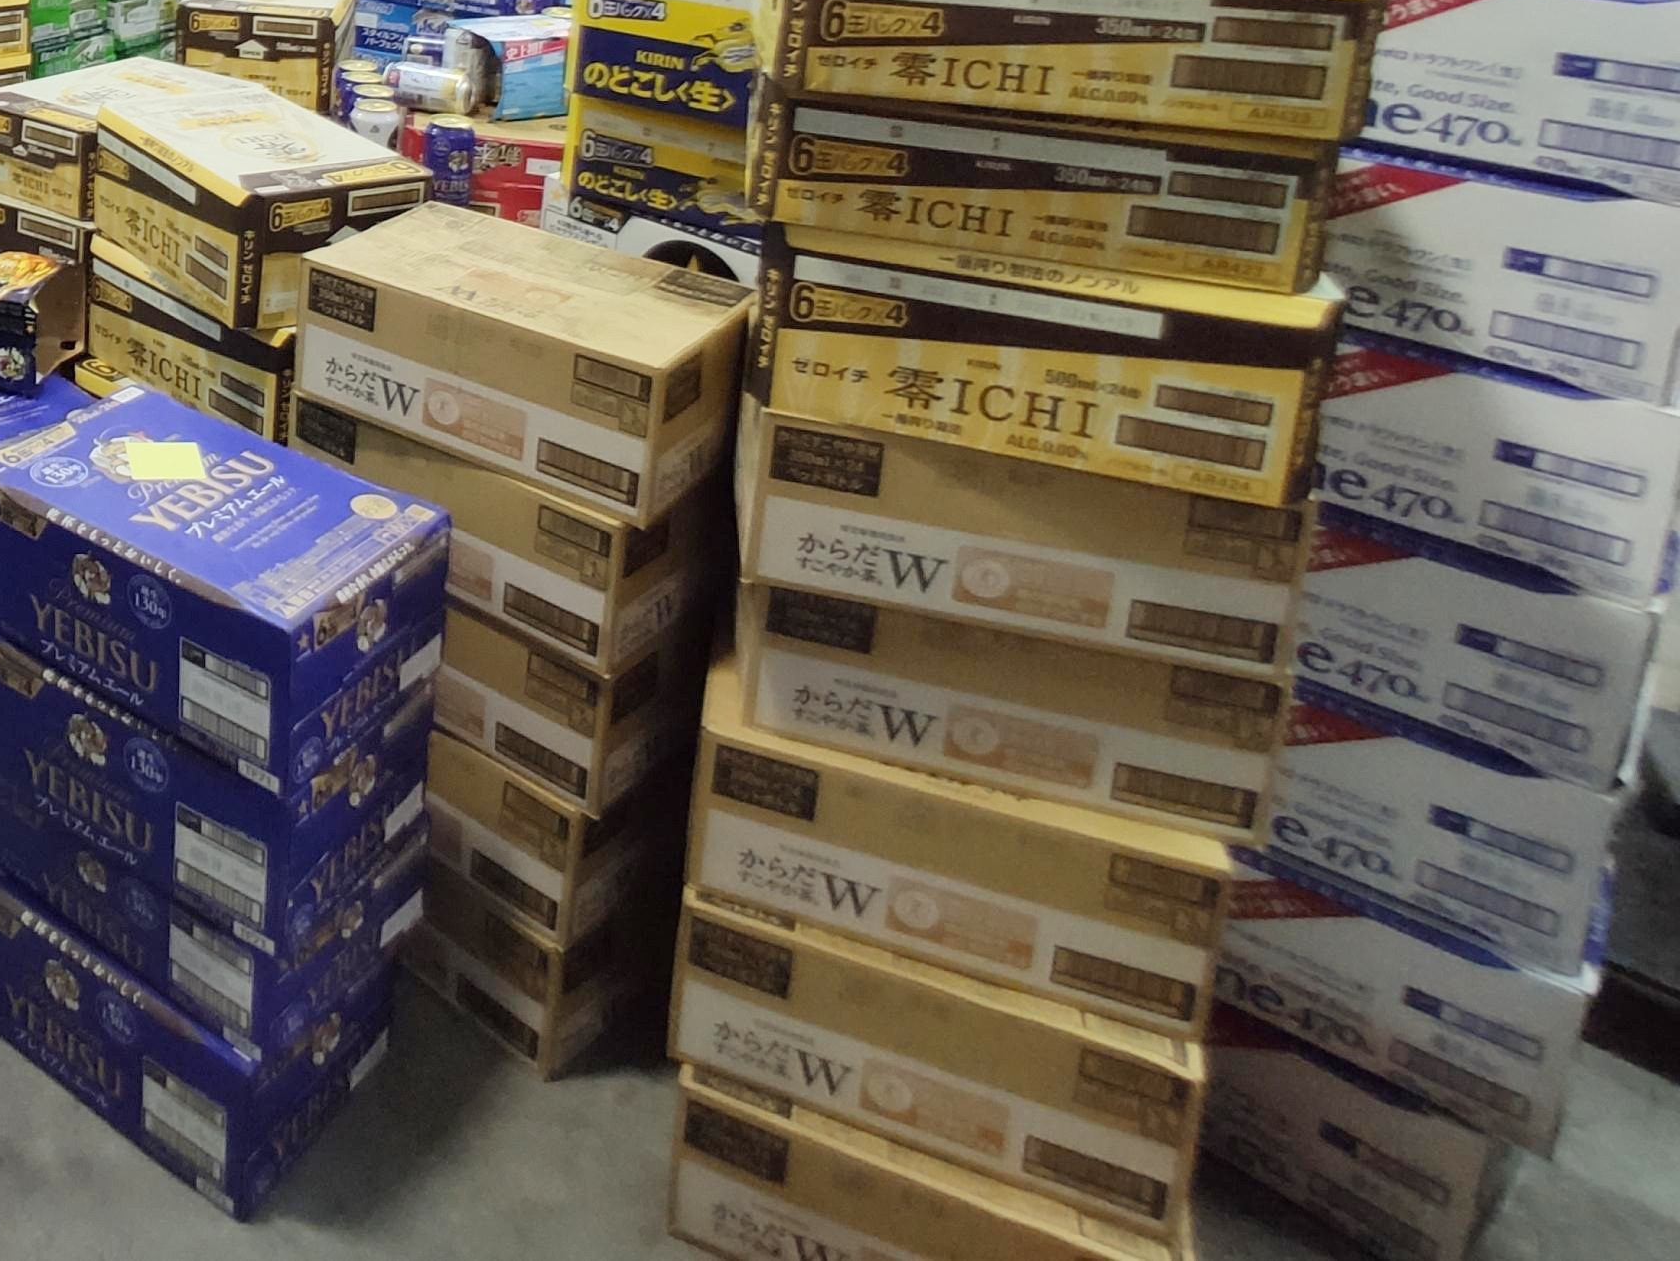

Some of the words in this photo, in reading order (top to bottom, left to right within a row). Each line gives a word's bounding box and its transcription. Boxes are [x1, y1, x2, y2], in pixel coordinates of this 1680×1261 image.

[635, 50, 685, 71] KIRIN
[889, 52, 1055, 96] 零ICHI
[1407, 84, 1463, 105] Good
[856, 189, 1014, 237] 零ICHI
[124, 206, 181, 268] 零ICHI
[127, 340, 202, 402] 零ICHI
[325, 357, 376, 390] からだ
[791, 357, 870, 383] ゼロイチ
[377, 375, 419, 417] W
[884, 366, 1099, 439] 零ICHI
[129, 450, 276, 531] YEBISU
[797, 532, 881, 567] からだ
[882, 548, 950, 593] W
[30, 593, 158, 690] YEBISU
[792, 685, 873, 721] からだ
[873, 702, 940, 748] W
[24, 746, 152, 851] YEBISU
[737, 848, 818, 887] からだ
[820, 872, 884, 918] W
[793, 1047, 856, 1097] W
